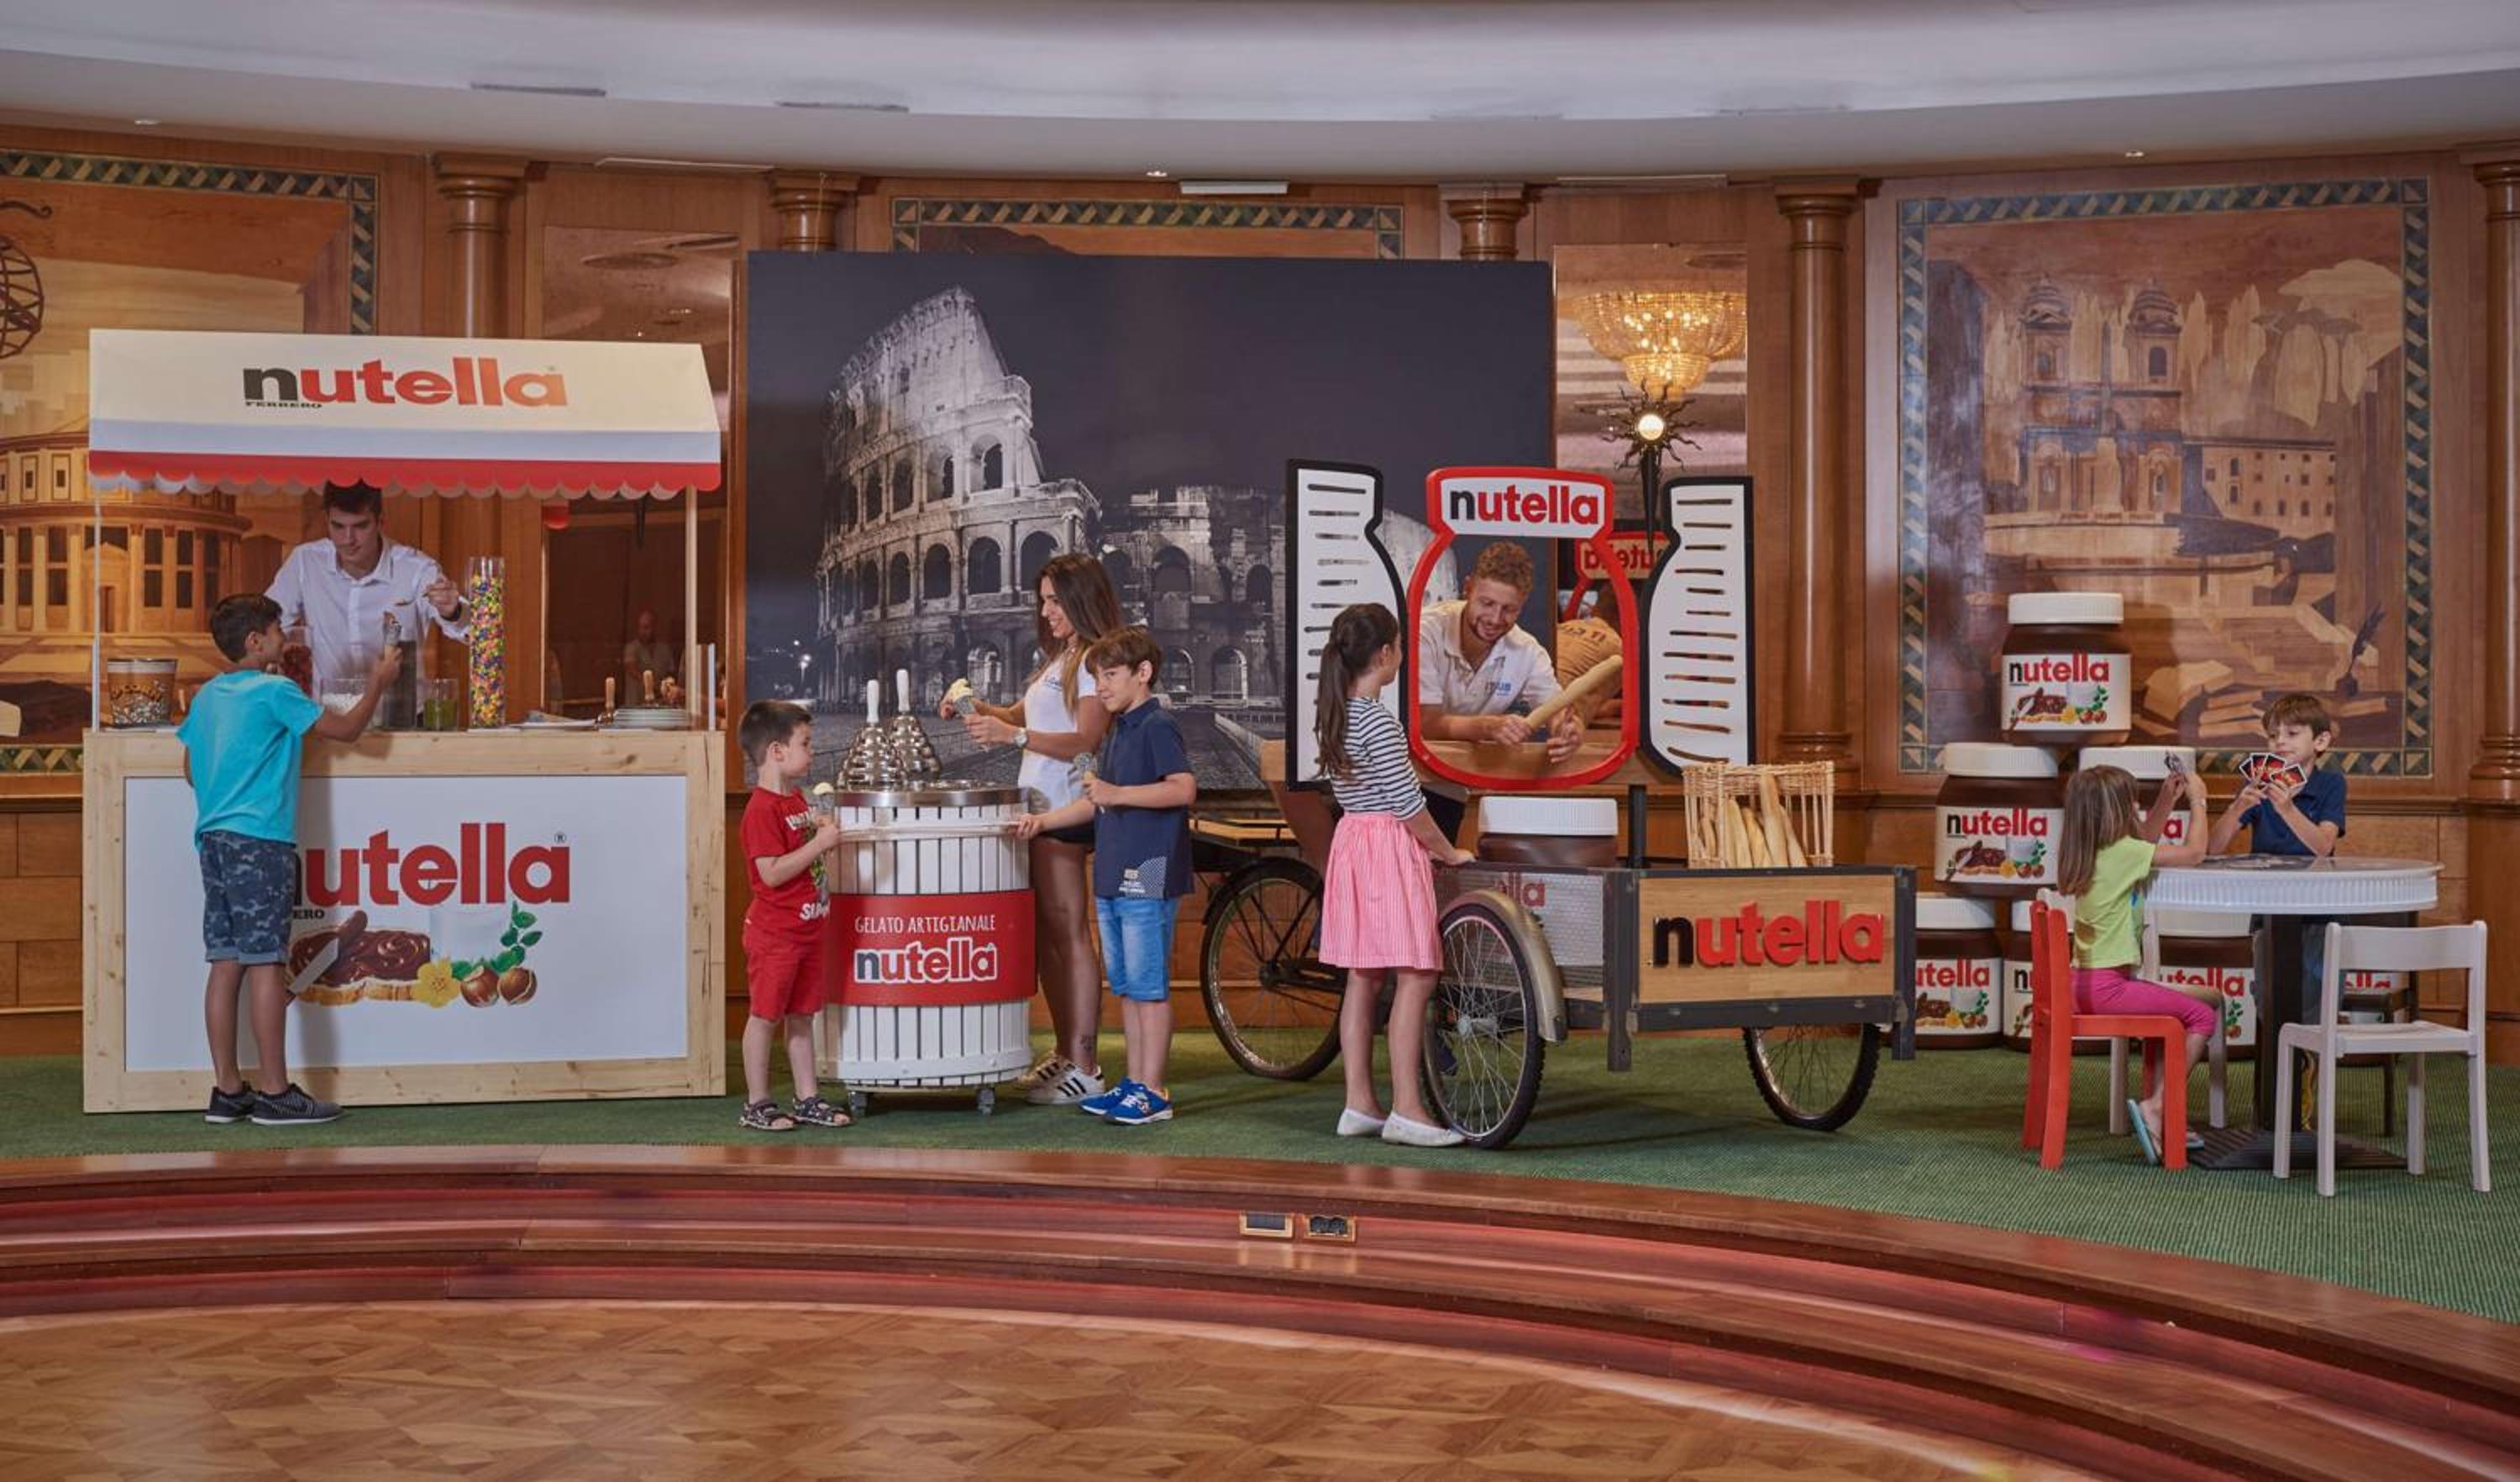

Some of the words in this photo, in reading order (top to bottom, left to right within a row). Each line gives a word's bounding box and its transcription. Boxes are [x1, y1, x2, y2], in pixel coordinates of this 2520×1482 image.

[243, 357, 568, 406] nutella
[1450, 485, 1599, 524] nutella
[2009, 649, 2109, 682] nutella
[1947, 807, 2047, 836] nutella
[294, 822, 570, 907] utella
[854, 917, 904, 933] GELATO
[908, 914, 996, 933] ARTIGIANALE
[1653, 901, 1884, 967] nutella
[854, 937, 998, 983] nutella
